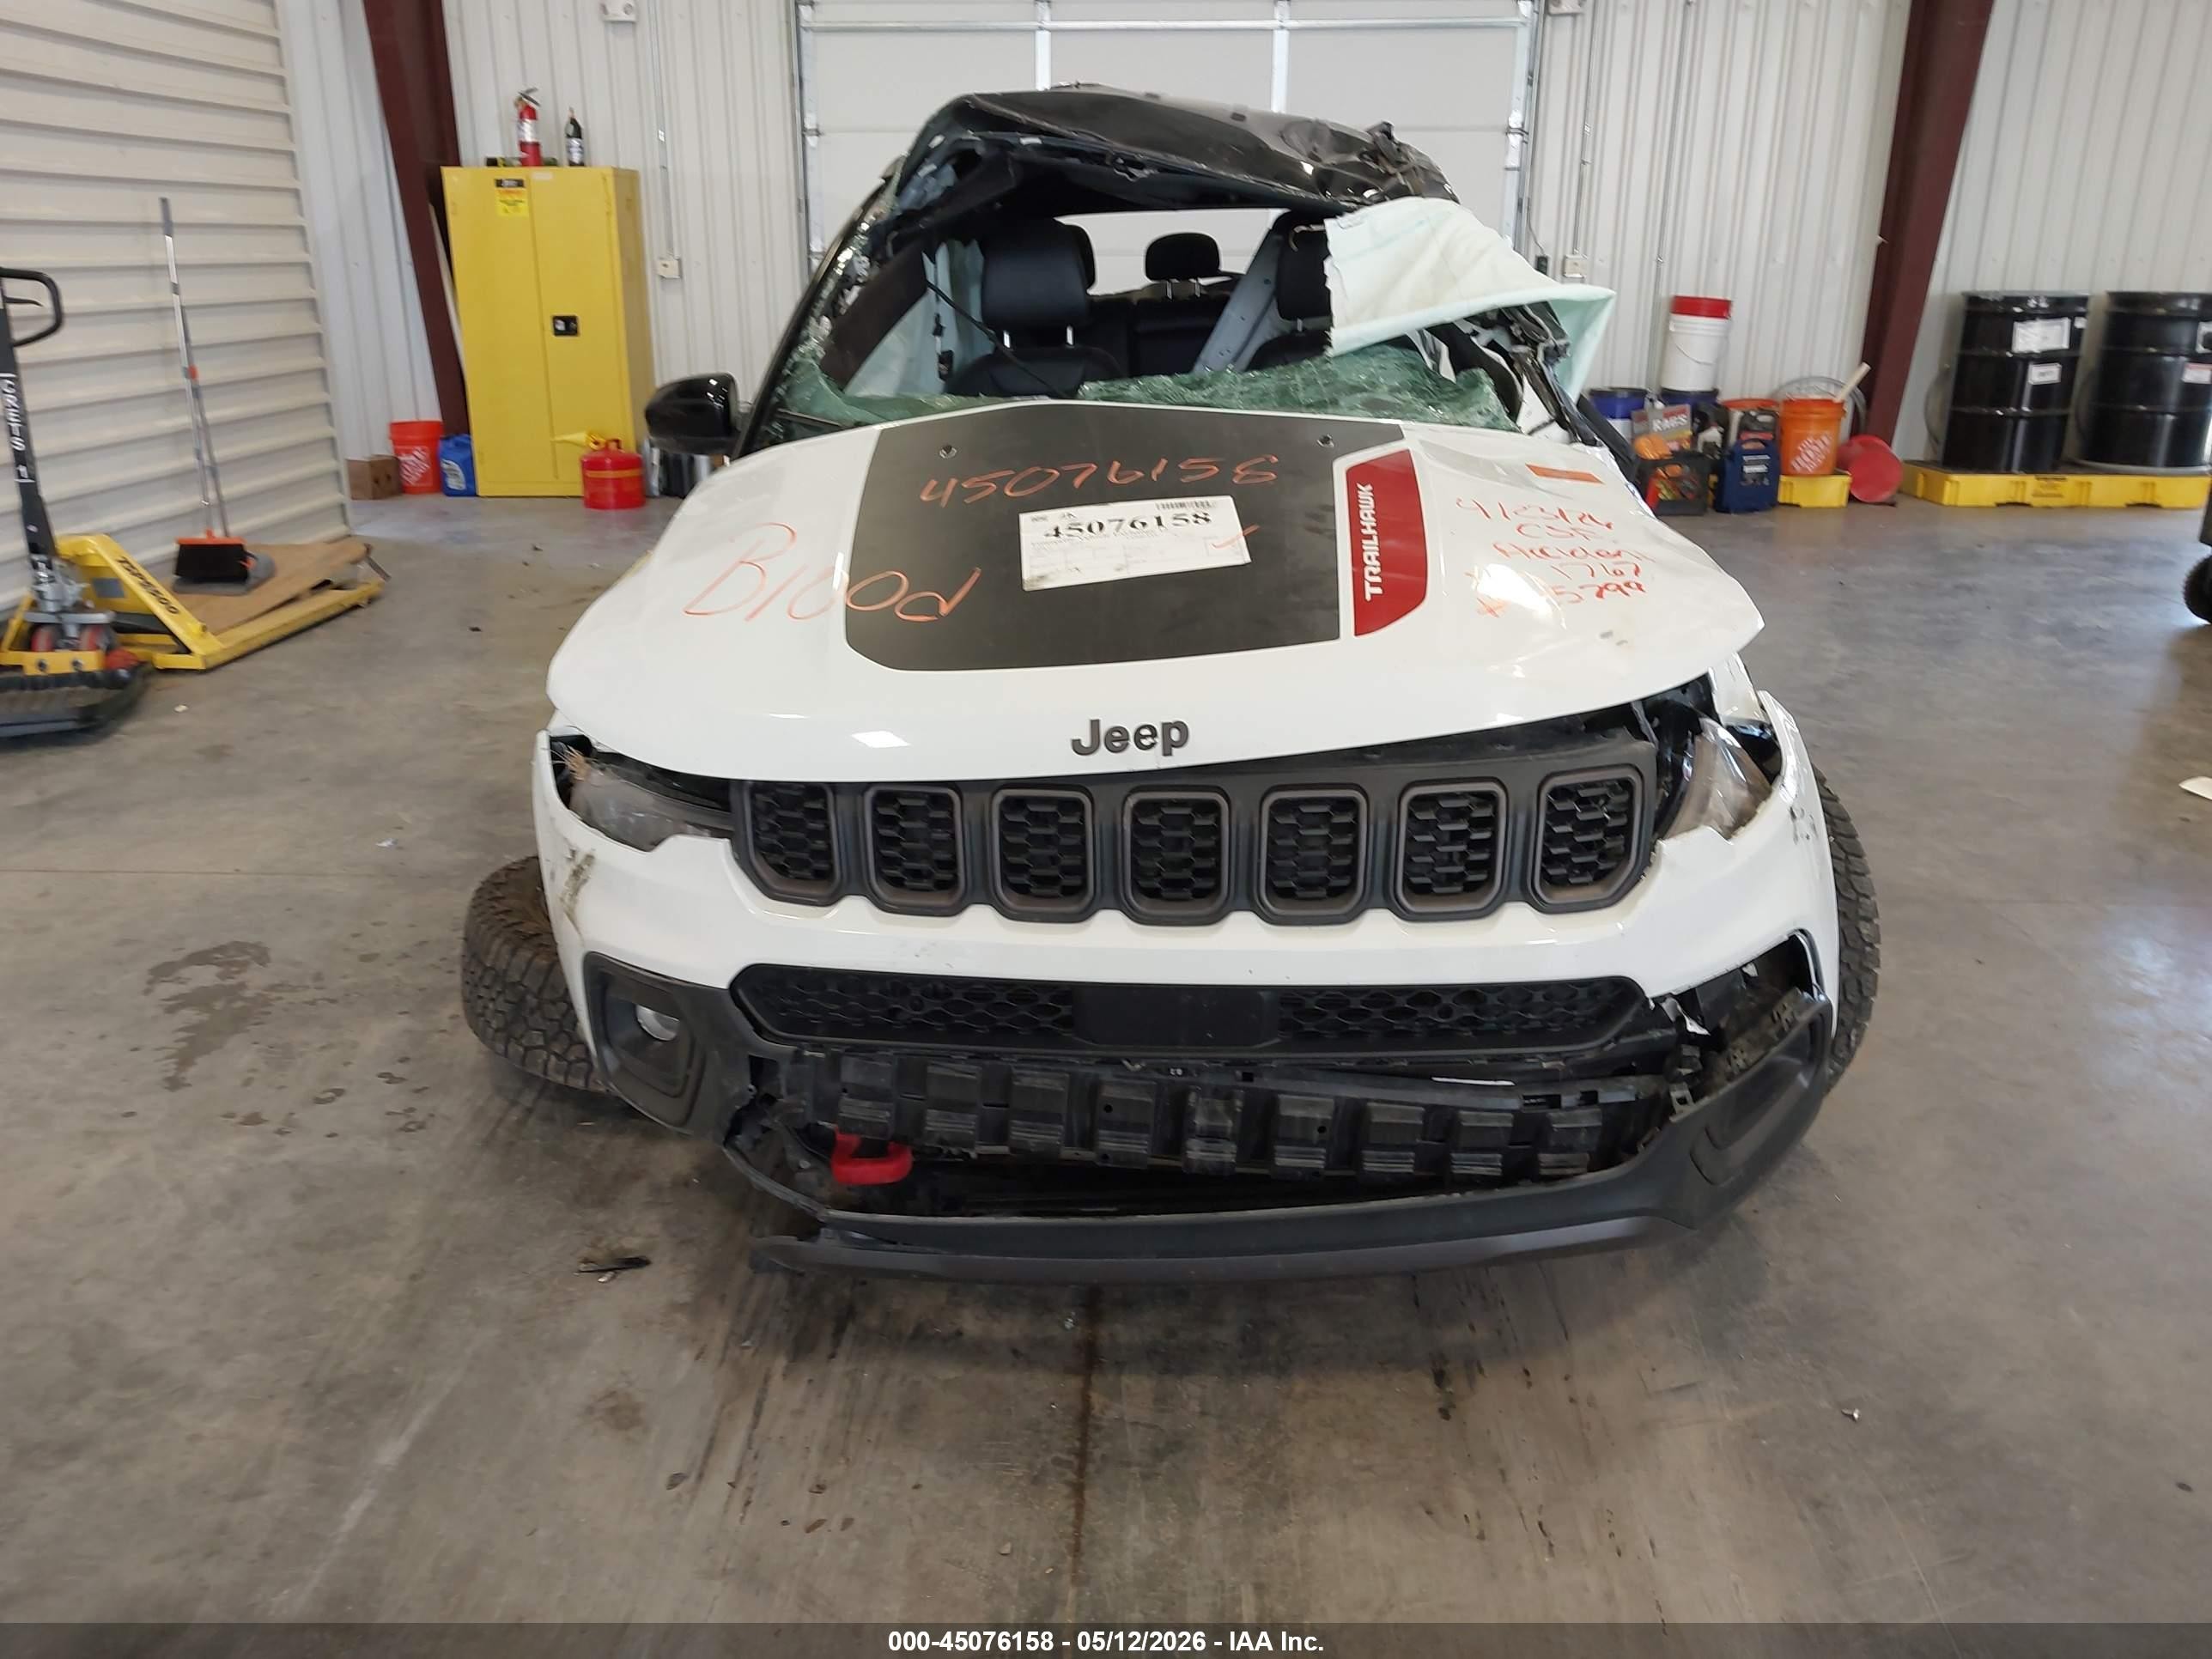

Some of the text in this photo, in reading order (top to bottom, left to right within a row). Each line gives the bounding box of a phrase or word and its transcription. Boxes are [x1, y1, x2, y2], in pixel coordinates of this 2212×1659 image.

[1042, 511, 1212, 540] 45076158
[1356, 482, 1384, 602] TRAILHAWK
[1072, 719, 1189, 757] Jeep
